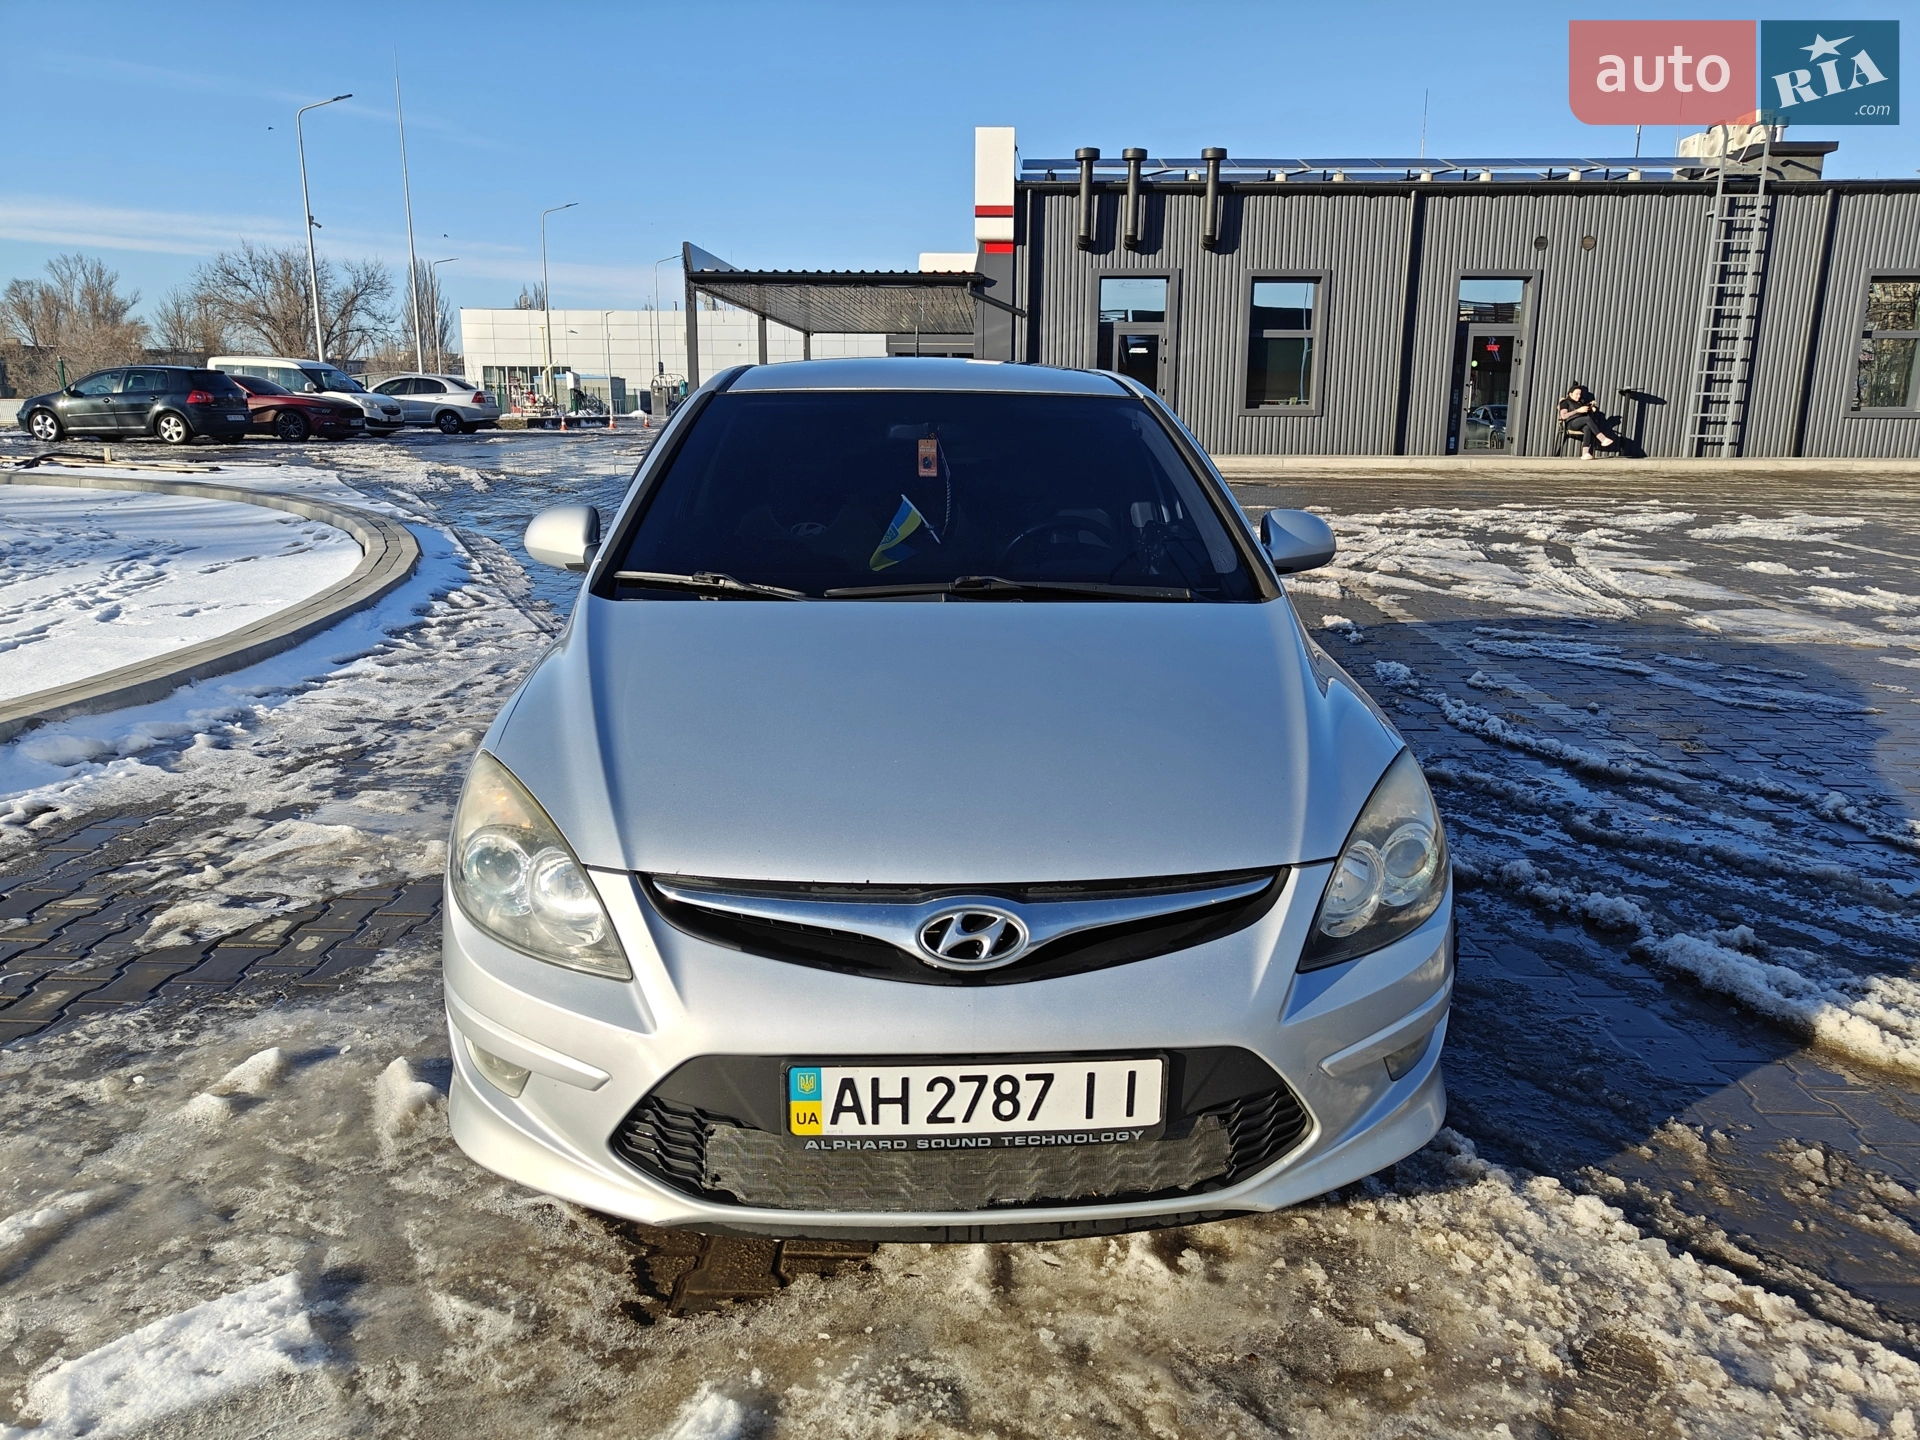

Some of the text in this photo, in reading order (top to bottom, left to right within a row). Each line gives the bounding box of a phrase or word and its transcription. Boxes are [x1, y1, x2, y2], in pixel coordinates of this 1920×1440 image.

[829, 1077, 910, 1126] AH
[926, 1073, 1055, 1124] 2787
[796, 1112, 819, 1125] UA
[804, 1130, 1144, 1150] ALPHARD SOUND TECHNOLOGY
